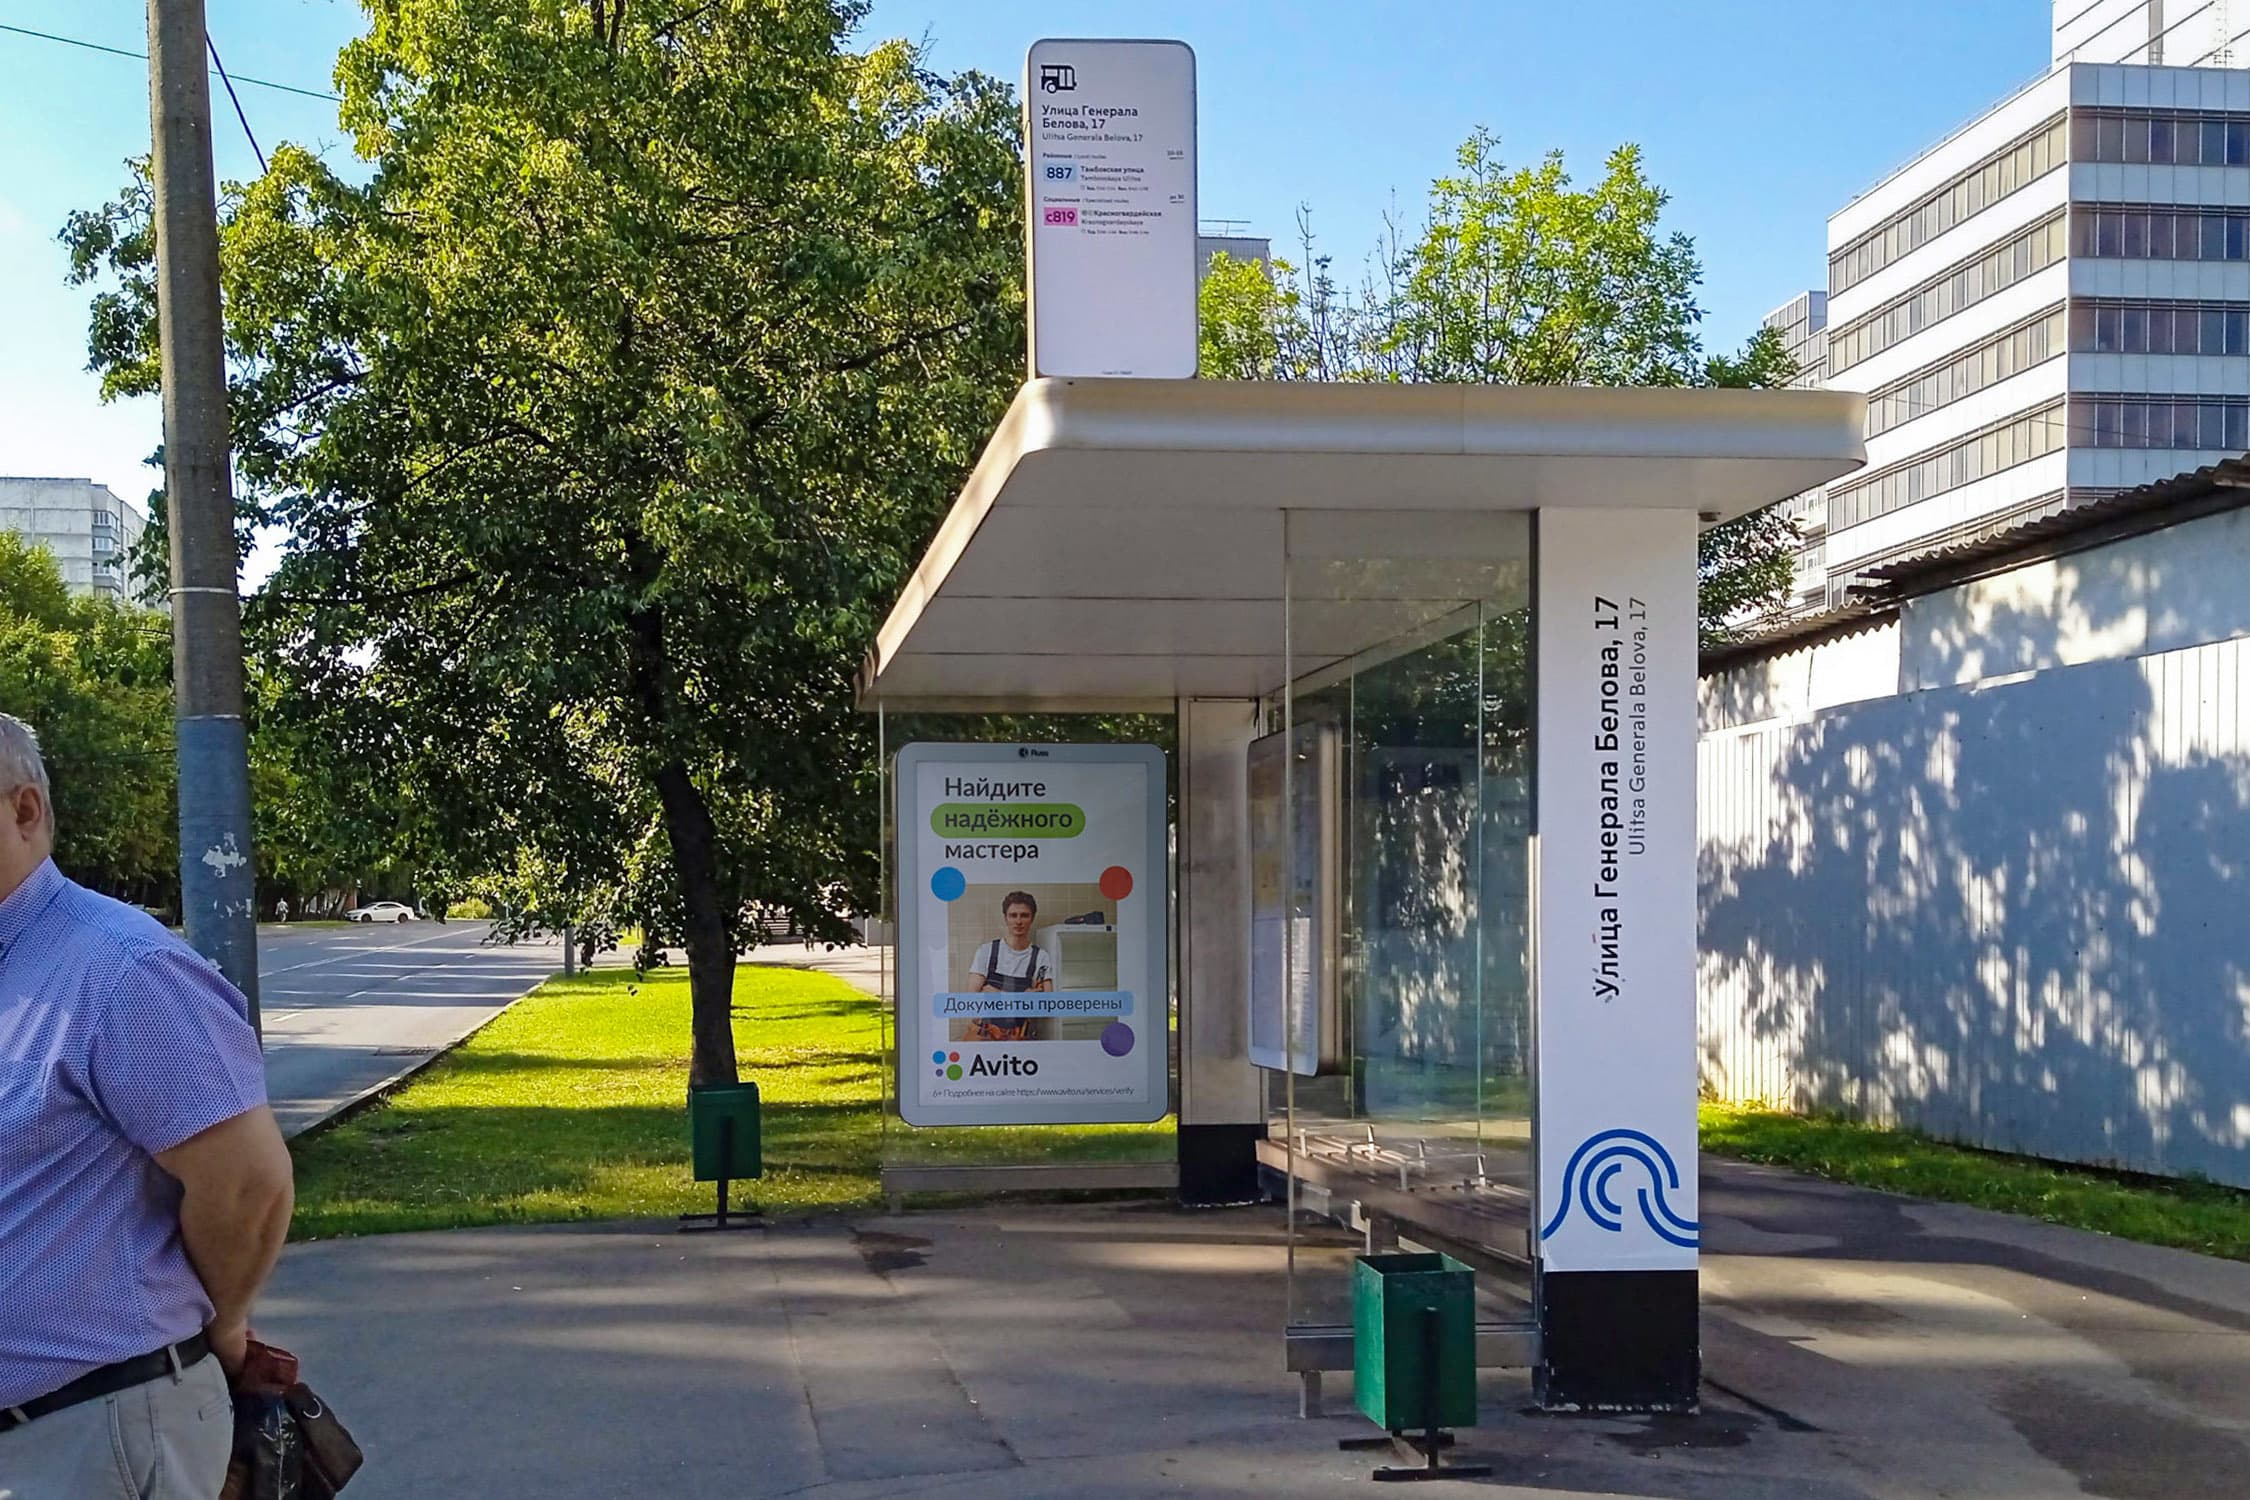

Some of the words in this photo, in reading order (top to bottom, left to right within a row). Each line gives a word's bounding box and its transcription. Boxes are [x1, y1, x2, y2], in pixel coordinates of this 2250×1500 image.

[1042, 104, 1079, 117] Улица
[1082, 105, 1138, 118] Генерала
[1042, 117, 1089, 130] Белова,
[1091, 118, 1106, 129] 17
[1133, 133, 1143, 142] 17
[1046, 166, 1073, 179] 887
[1595, 596, 1619, 630] 17
[1629, 597, 1646, 620] 17
[1629, 626, 1648, 696] Belova,
[1594, 639, 1623, 751] Белова,
[1629, 703, 1646, 793] Generala
[945, 777, 1046, 801] Найдите
[945, 808, 1073, 832] надёжного
[1594, 761, 1624, 897] Генерала
[1628, 799, 1646, 855] Ulitsa
[945, 844, 1039, 862] мастера
[1595, 908, 1623, 996] Улица
[944, 997, 1034, 1015] Документы
[1038, 999, 1122, 1013] проверены
[969, 1053, 1039, 1077] Avito
[943, 1088, 985, 1099] Подробнее
[996, 1088, 1016, 1098] сайте
